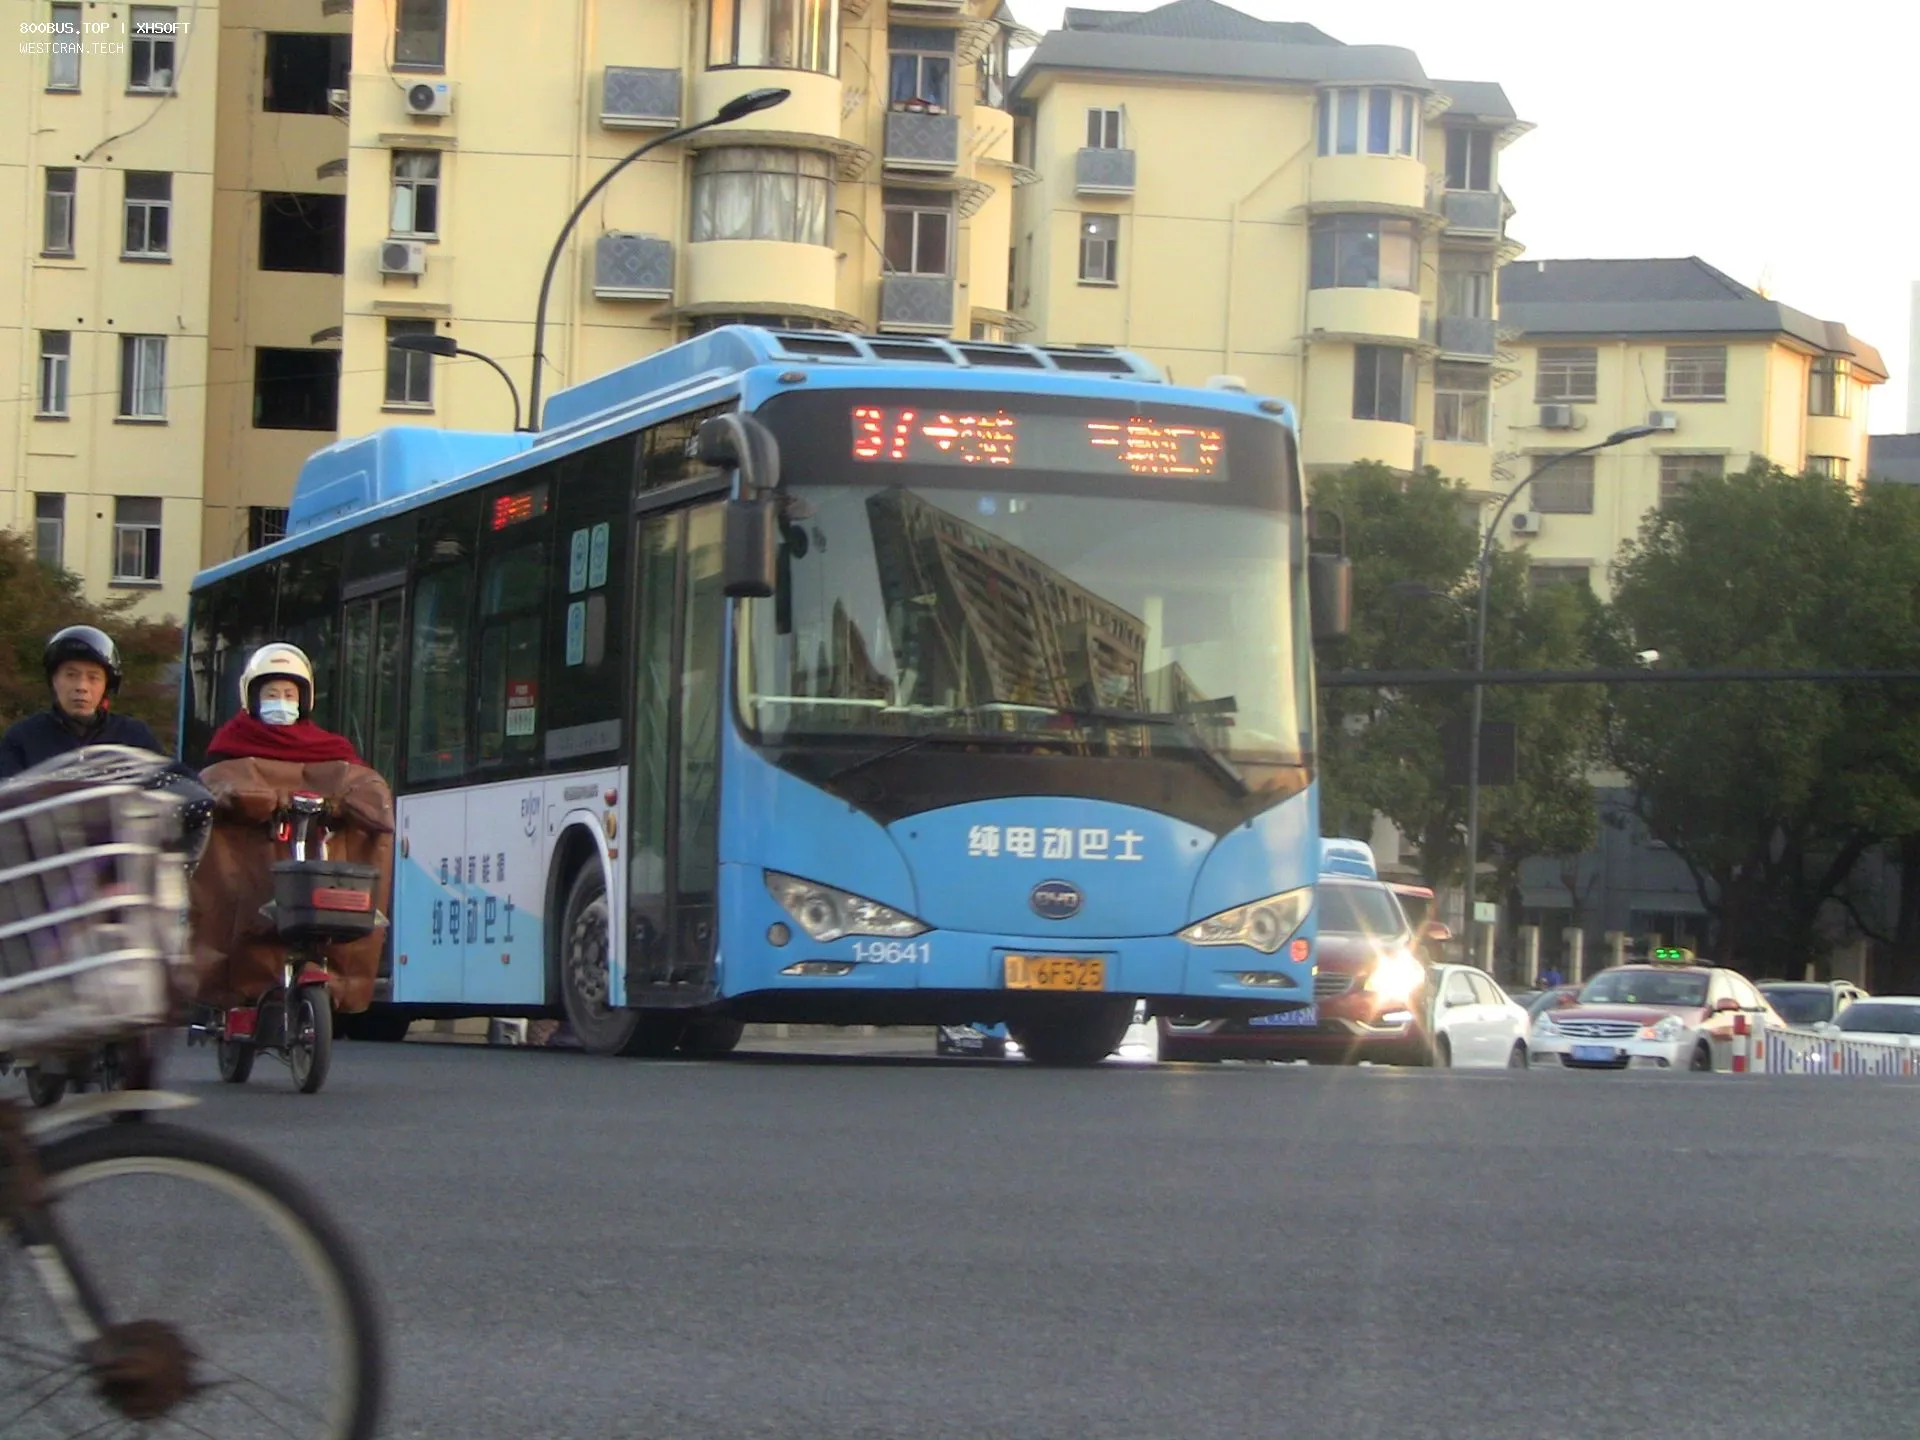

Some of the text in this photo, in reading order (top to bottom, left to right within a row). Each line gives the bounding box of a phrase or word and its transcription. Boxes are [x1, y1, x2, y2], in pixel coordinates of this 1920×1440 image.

[967, 824, 1144, 861] 纯电动巴士
[851, 941, 930, 964] 1-9641
